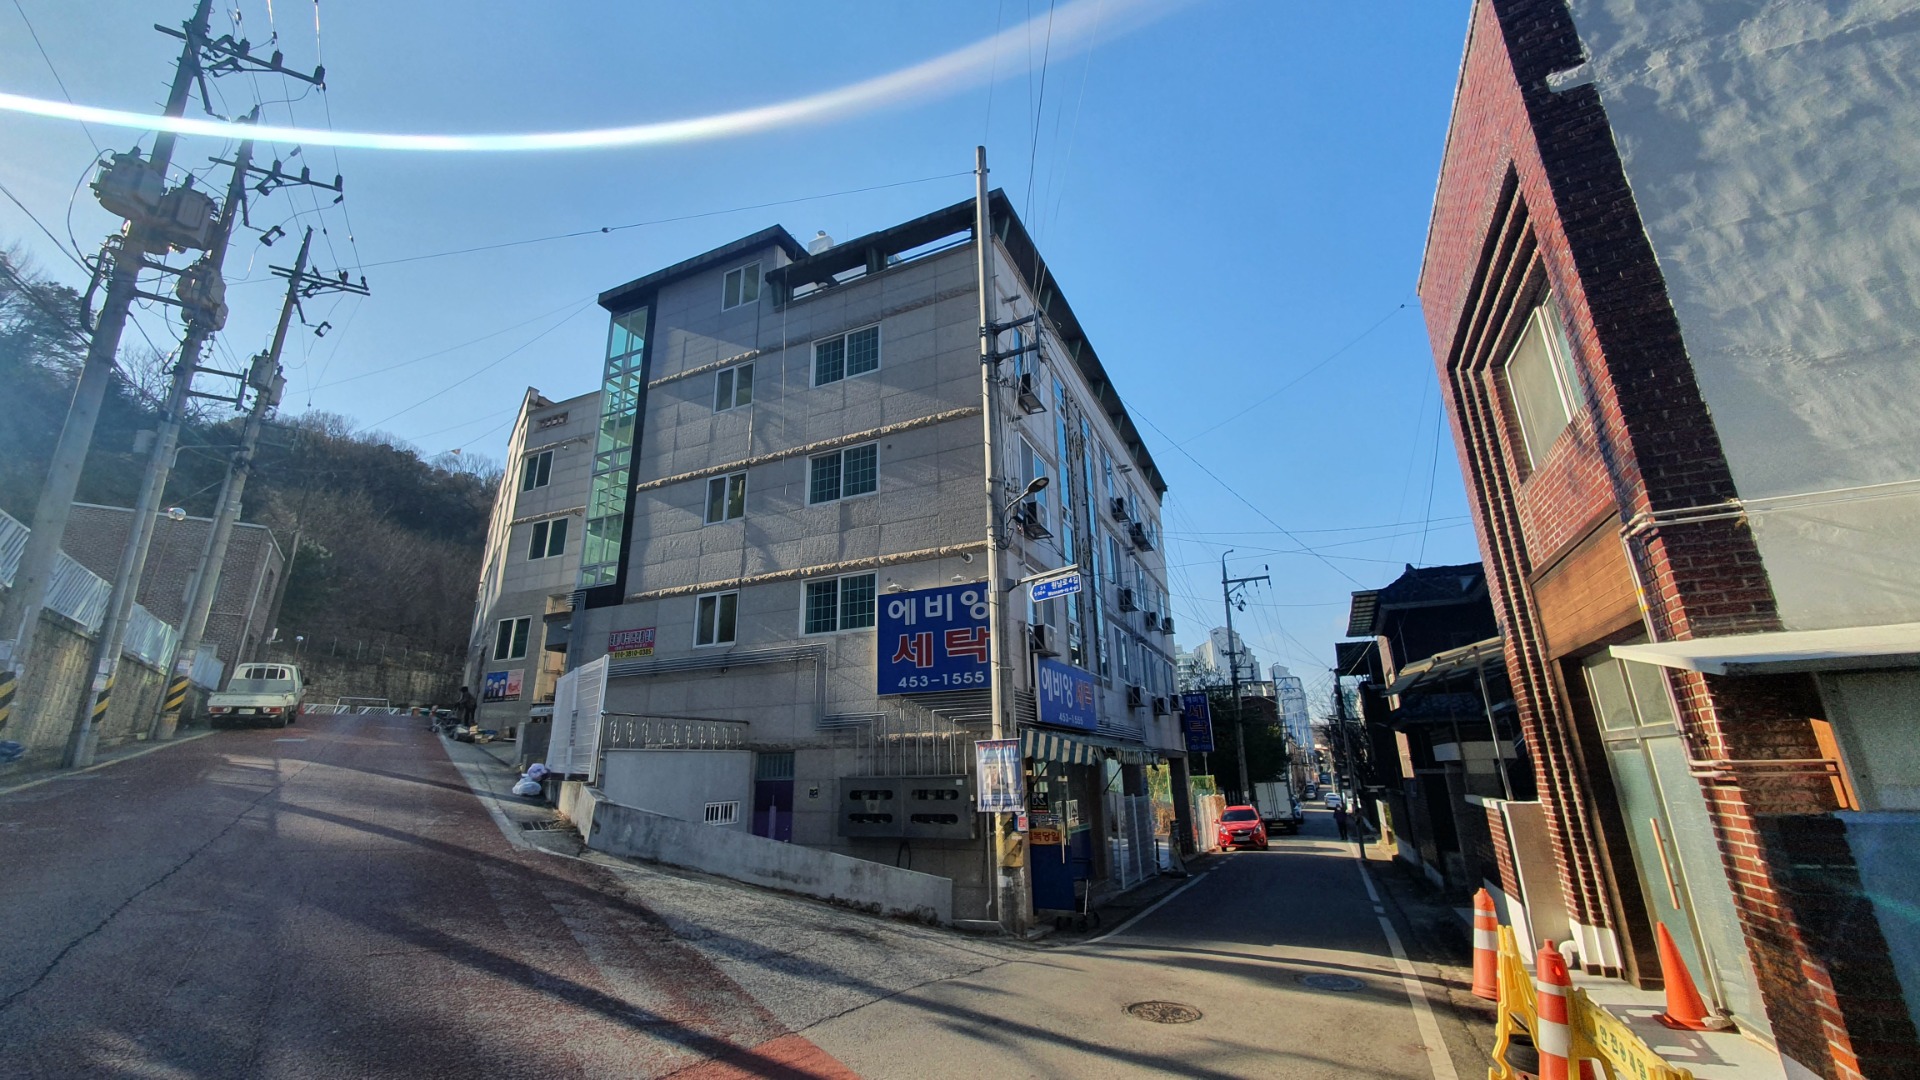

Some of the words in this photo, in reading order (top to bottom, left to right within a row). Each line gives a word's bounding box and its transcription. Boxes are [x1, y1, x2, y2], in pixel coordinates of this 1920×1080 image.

[888, 589, 990, 626] 에비앙
[892, 626, 991, 668] 세탁
[898, 671, 985, 688] 453-1555
[1042, 667, 1073, 709] 에비앙
[1187, 704, 1208, 735] 세탁
